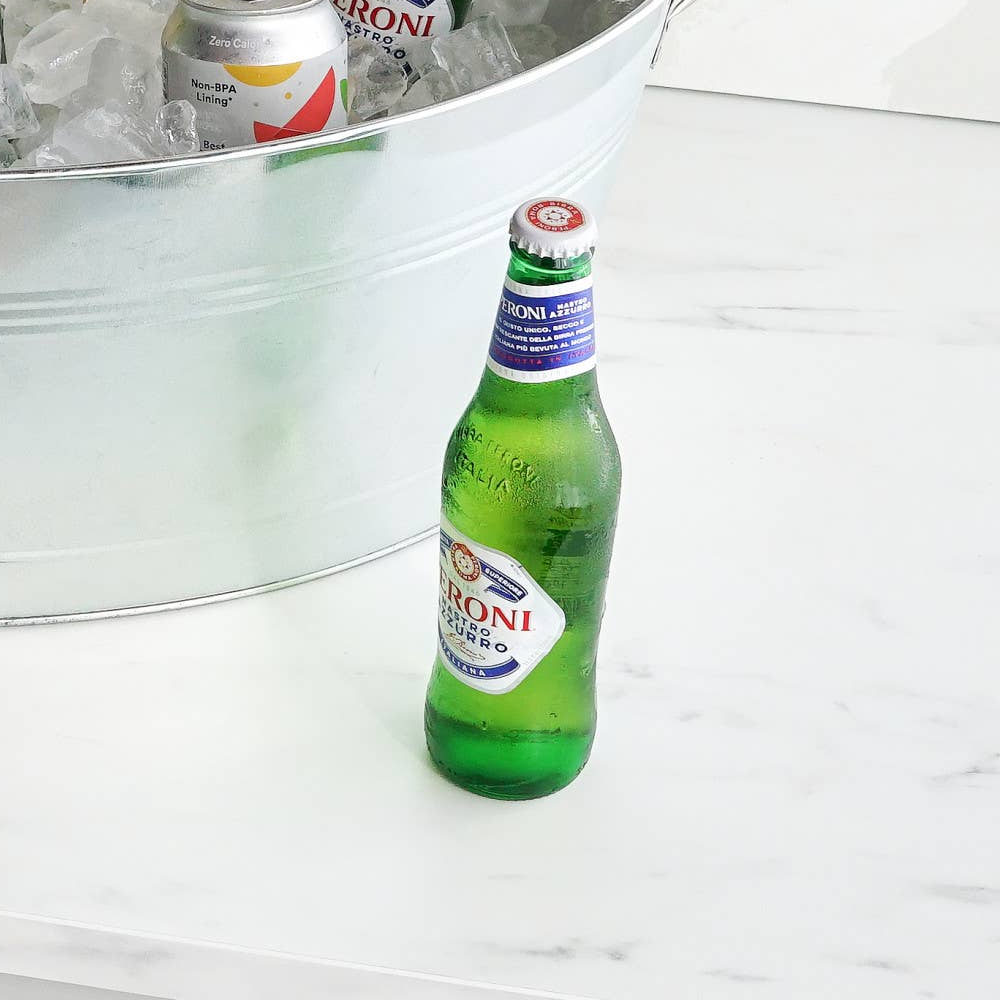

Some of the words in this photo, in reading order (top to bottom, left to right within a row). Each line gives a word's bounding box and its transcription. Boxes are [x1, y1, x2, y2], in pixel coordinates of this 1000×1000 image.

[208, 35, 231, 48] Zero
[191, 78, 237, 94] Non-BPA
[501, 300, 547, 320] ERONI
[549, 301, 592, 319] AZZURRO
[556, 297, 588, 310] NASTRO
[484, 567, 523, 597] SUPERIORE
[441, 566, 535, 632] ERONI
[441, 606, 508, 653] ZZURRO
